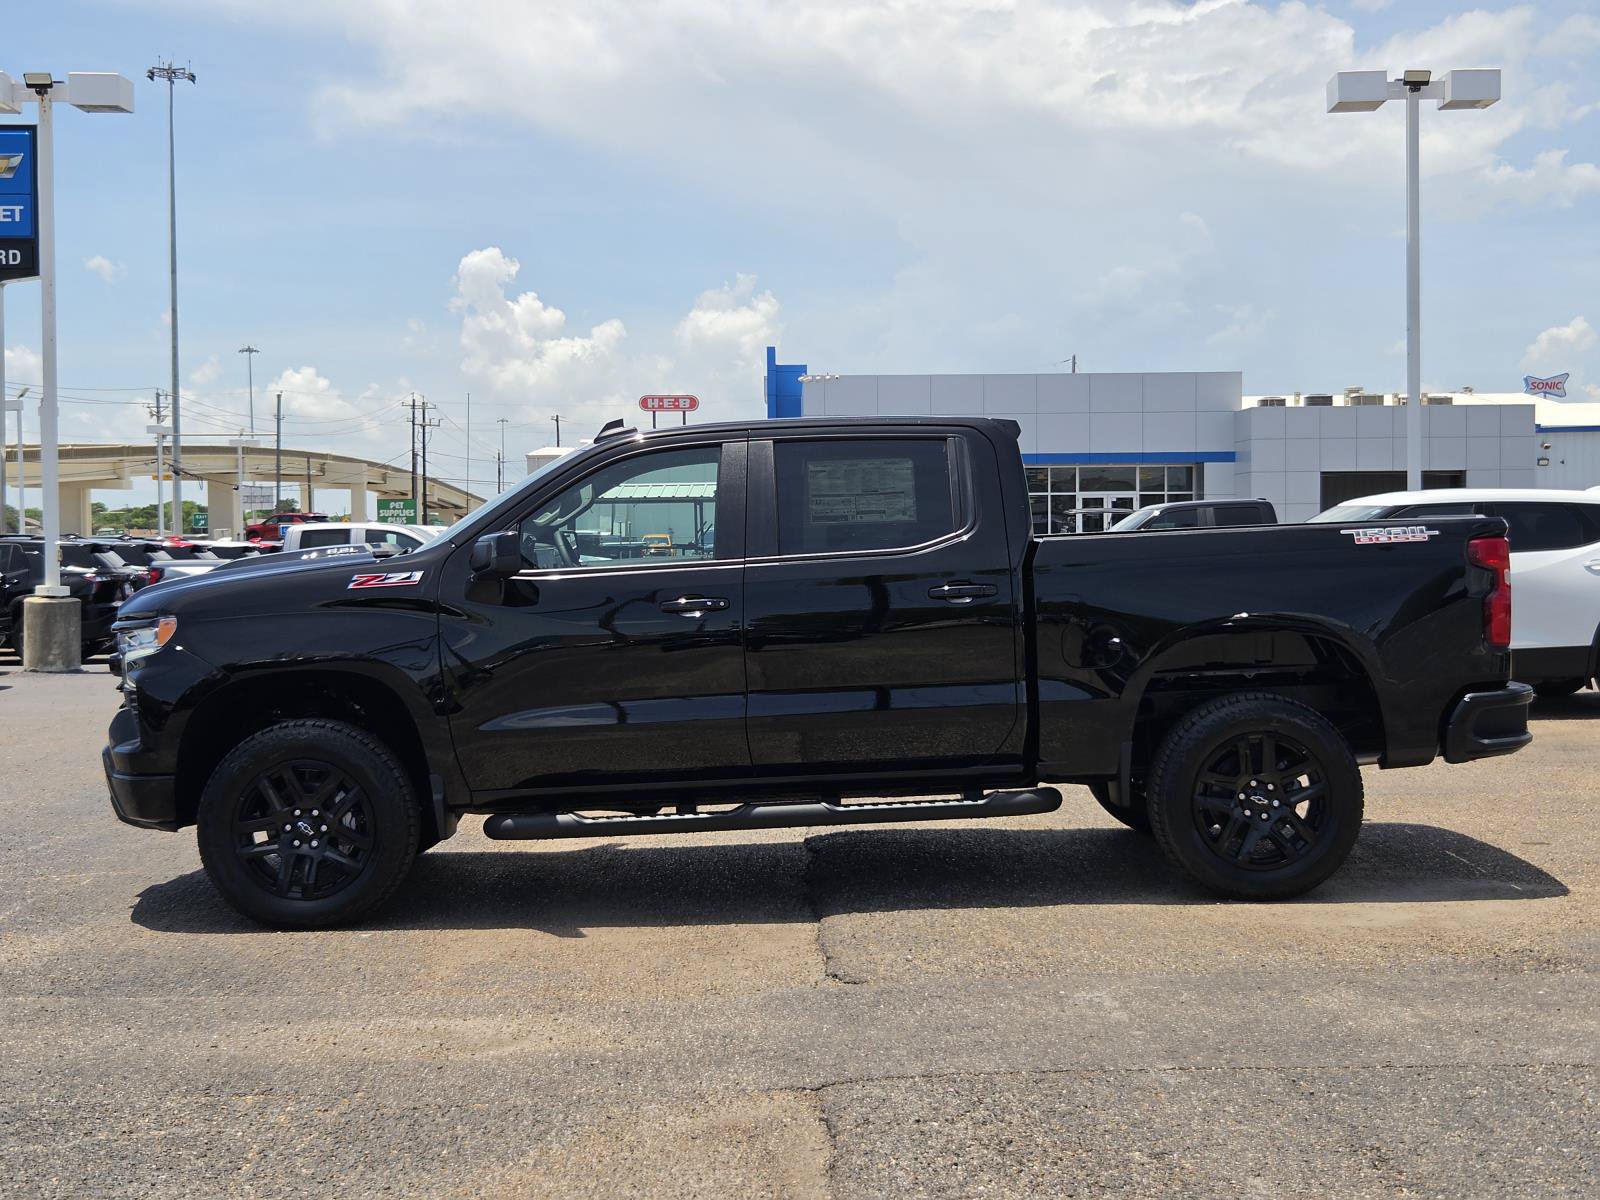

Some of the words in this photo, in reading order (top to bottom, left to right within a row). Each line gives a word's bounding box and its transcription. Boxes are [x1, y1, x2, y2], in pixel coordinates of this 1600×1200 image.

[1530, 381, 1562, 390] SONIC
[379, 509, 415, 517] SUPPLIES
[1340, 526, 1440, 537] TRAIL
[1354, 534, 1429, 544] BOSS
[347, 570, 425, 589] Z71
